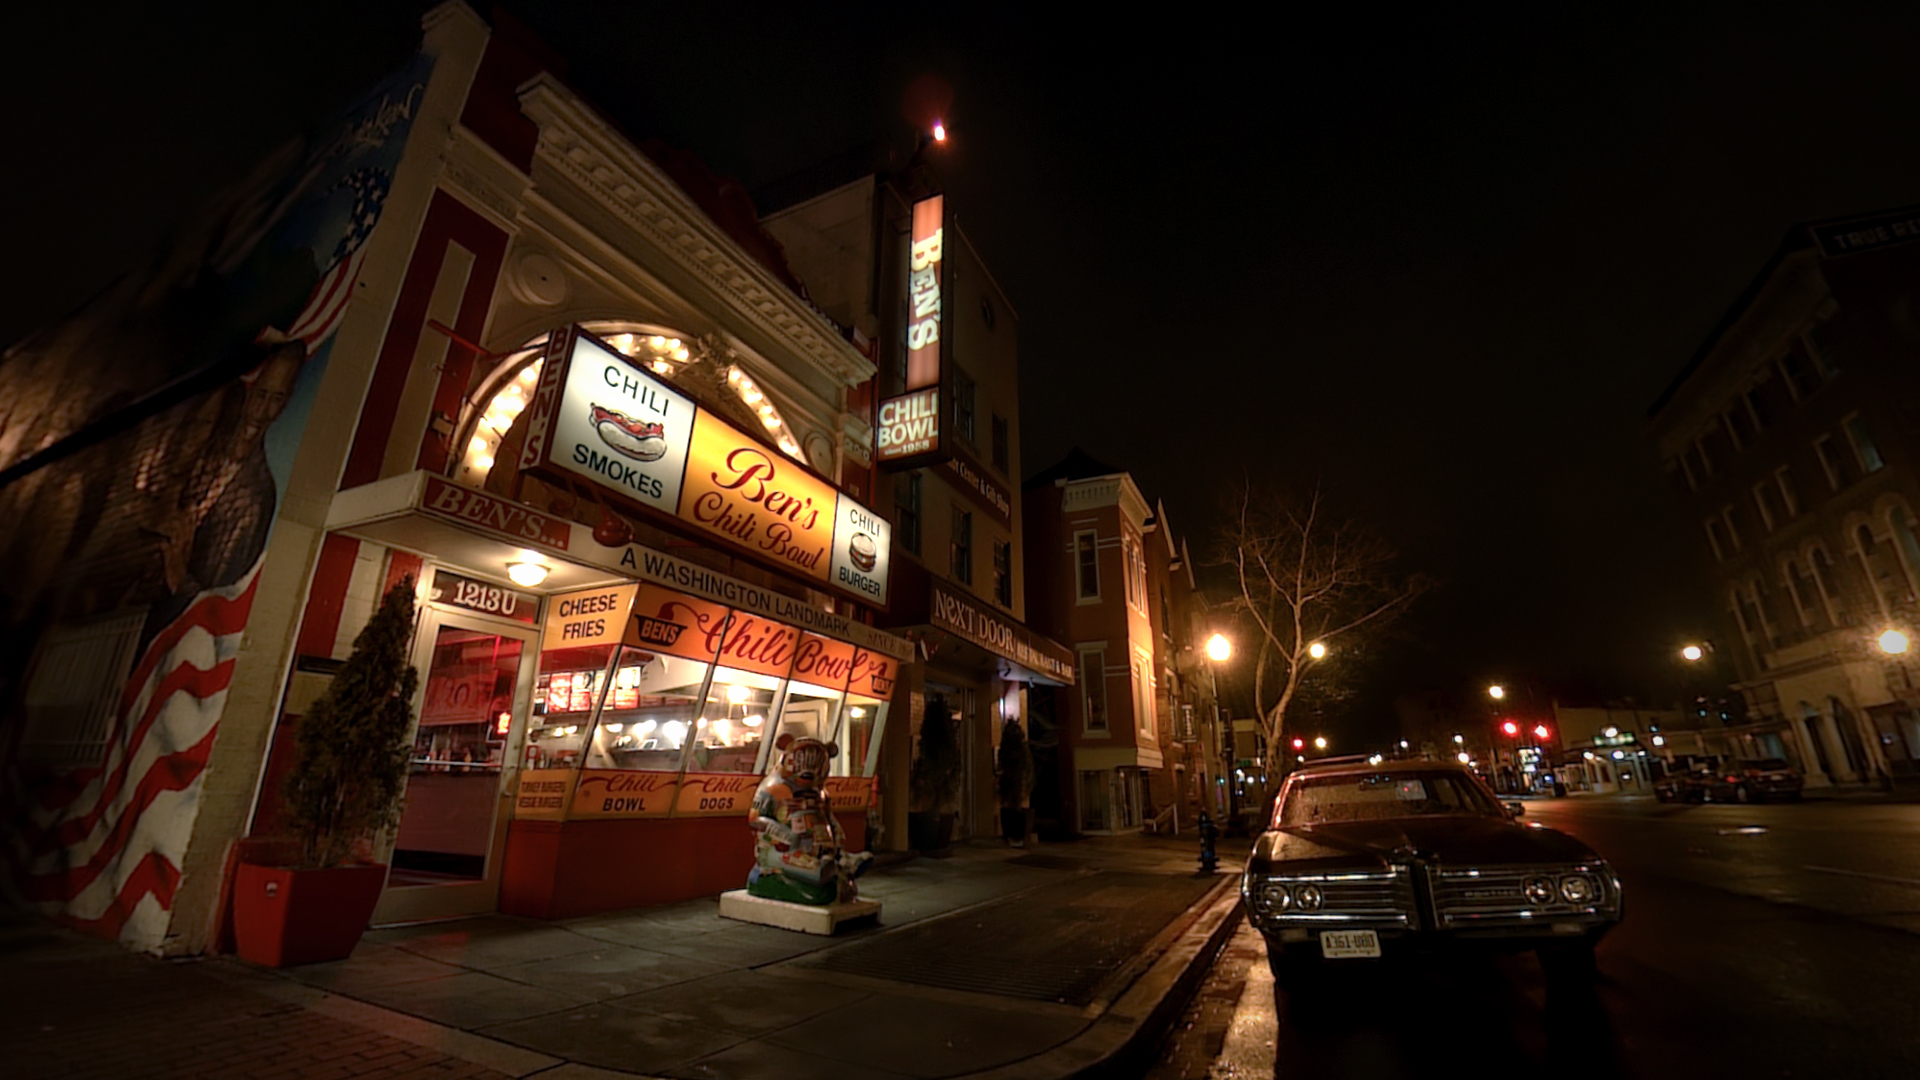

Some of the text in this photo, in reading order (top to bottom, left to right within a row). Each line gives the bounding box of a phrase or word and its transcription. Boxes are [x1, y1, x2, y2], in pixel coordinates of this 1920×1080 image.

[910, 228, 944, 351] BEN'S
[525, 327, 567, 466] BEN'S
[604, 365, 669, 417] CHILI
[878, 392, 937, 427] CHILI
[877, 419, 939, 449] BOWL
[573, 443, 664, 499] SMOKES
[711, 448, 820, 532] Ben's
[693, 491, 826, 572] Chili Bowl
[849, 509, 881, 538] CHILI
[620, 547, 851, 636] A WASHINGTON LANDMARK
[838, 565, 881, 597] BURGER
[559, 593, 618, 617] CHEESE
[562, 618, 605, 640] FRIES
[978, 613, 1014, 652] DOOR
[700, 612, 885, 683] Chili Bowl
[605, 770, 657, 792] Chili
[700, 774, 744, 794] Chili
[603, 797, 646, 812] BOWL
[700, 796, 734, 810] DOGS
[832, 795, 862, 807] URGERS
